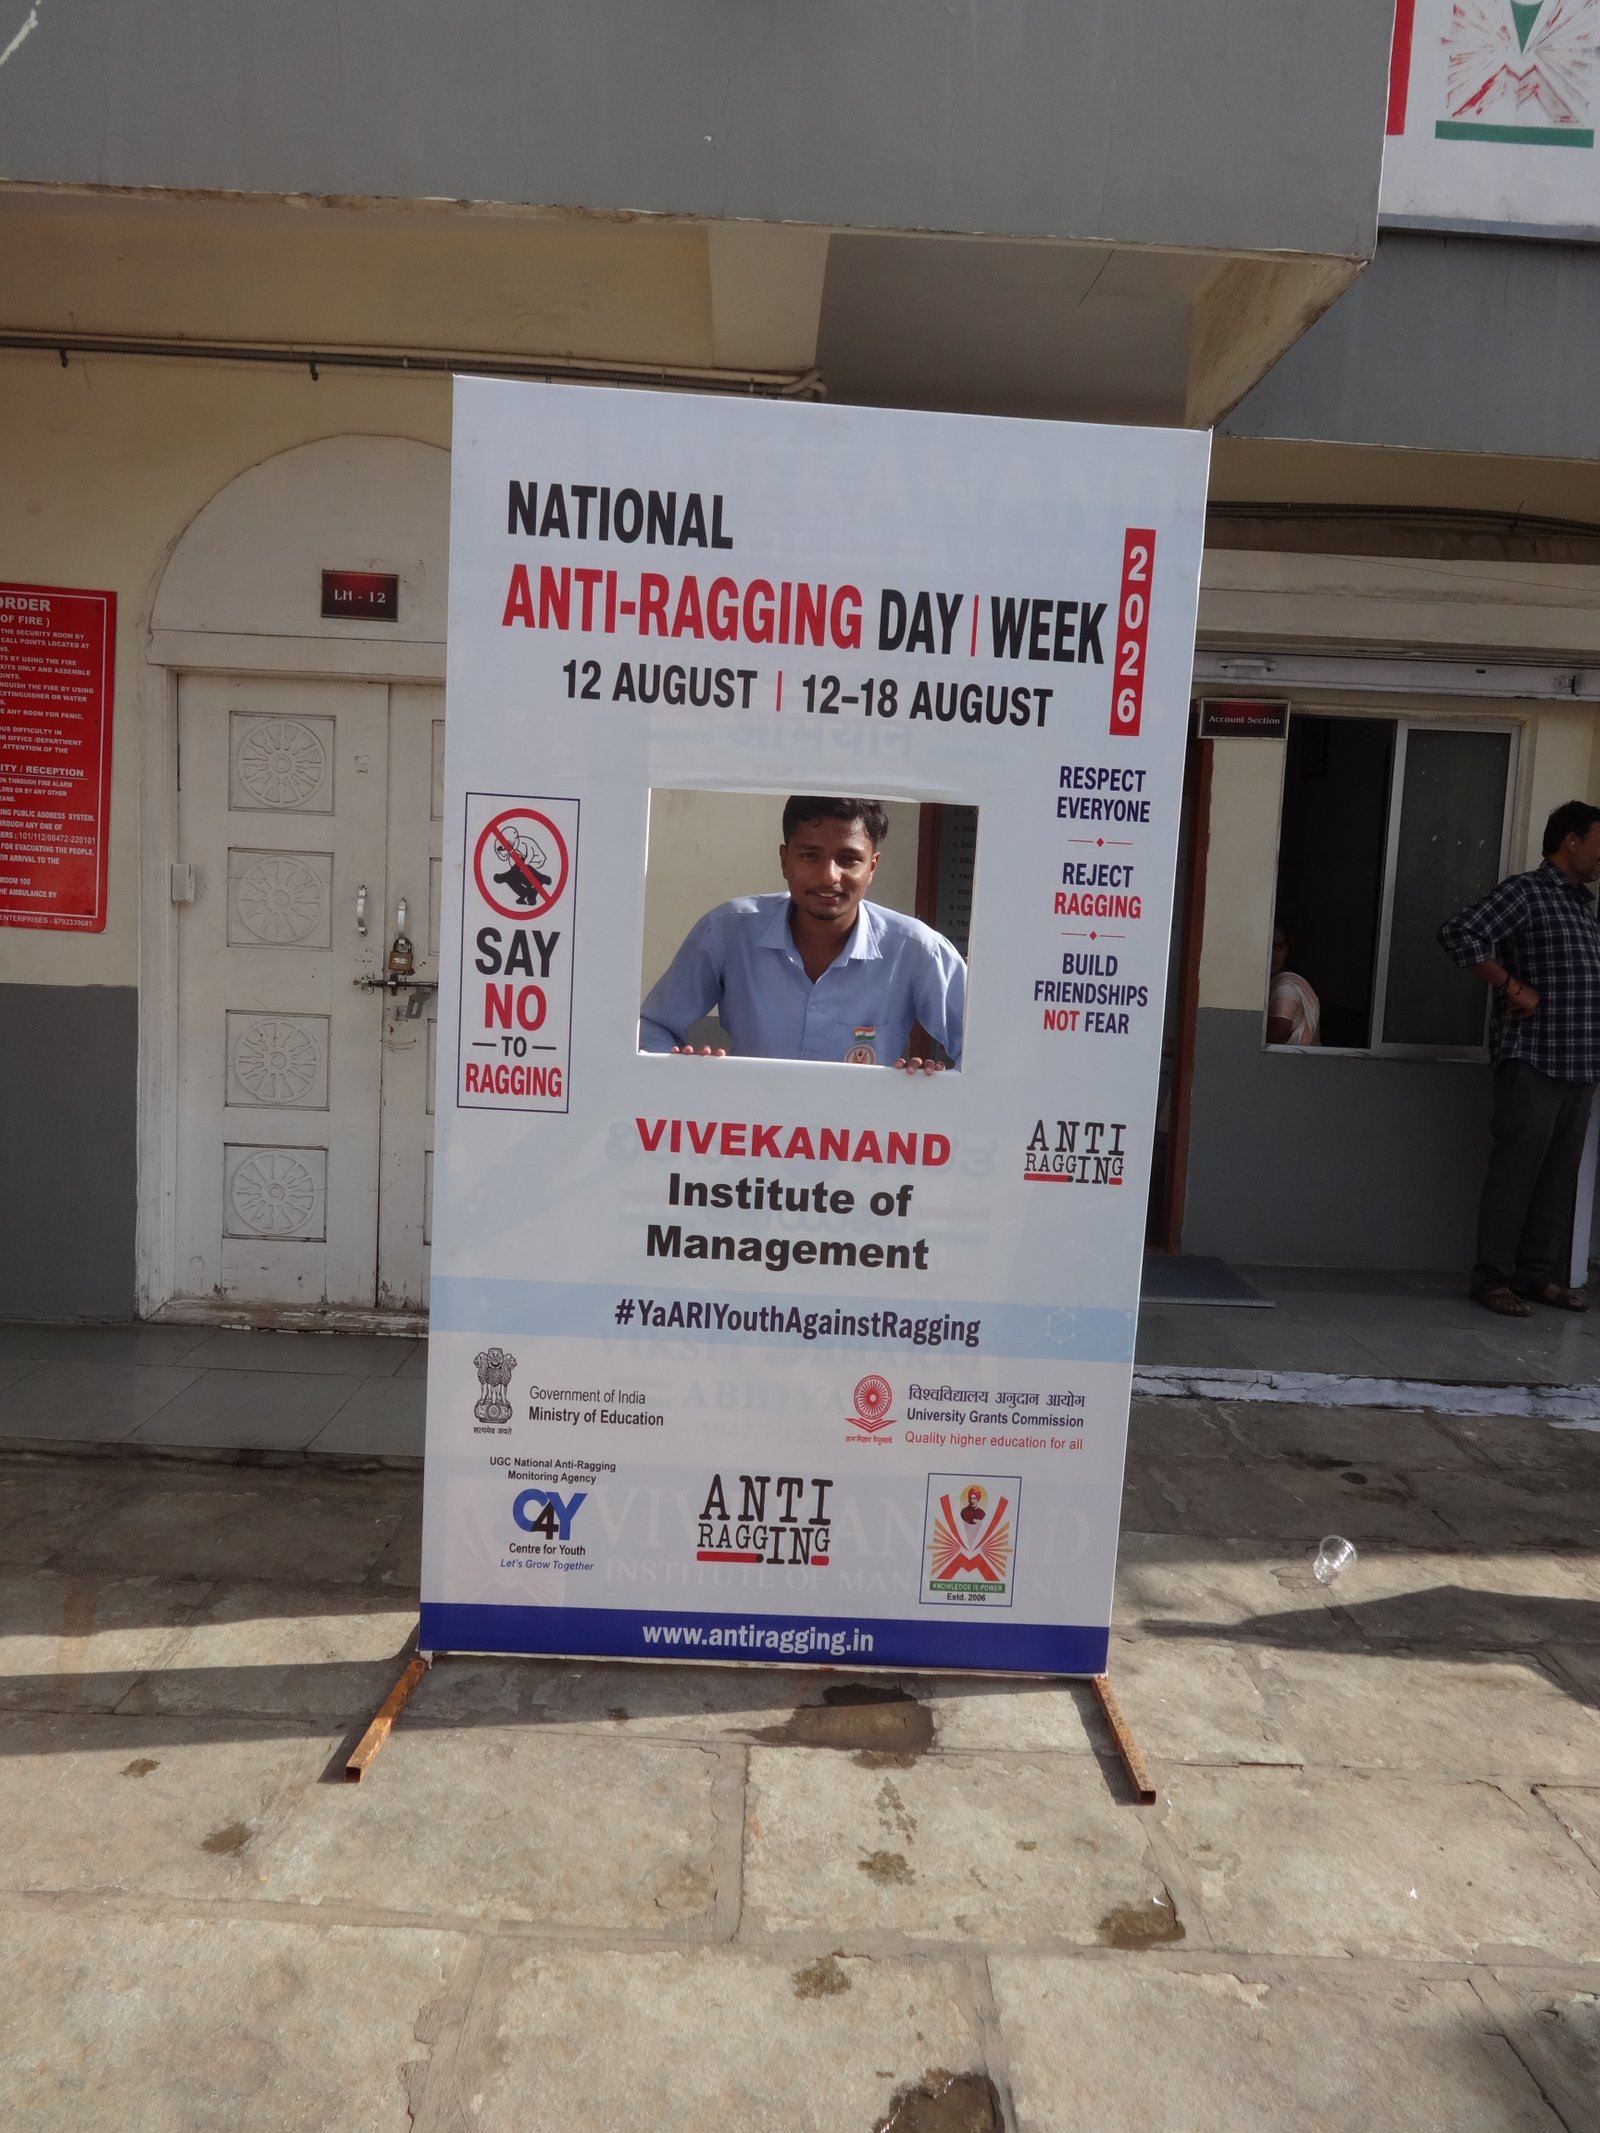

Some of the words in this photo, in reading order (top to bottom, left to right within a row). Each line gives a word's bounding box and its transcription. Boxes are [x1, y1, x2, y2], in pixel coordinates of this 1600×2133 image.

[508, 480, 733, 549] NATIONAL
[334, 589, 353, 601] LH
[369, 592, 386, 603] 12
[0, 614, 14, 623] OF
[18, 616, 43, 626] FIRE
[502, 563, 862, 650] ANTI-RAGGING
[878, 588, 964, 655] DAY
[991, 596, 1108, 664] WEEK
[16, 629, 50, 638] SECURITY
[1117, 546, 1148, 723] 2026
[48, 641, 80, 649] LOCATED
[54, 668, 91, 676] ASSEMBLE
[62, 694, 88, 702] WATER
[563, 659, 601, 700] 12
[612, 662, 758, 709] AUGUST
[909, 680, 1053, 727] AUGUST
[12, 726, 53, 735] DIFFICULTY
[1208, 714, 1245, 724] Account
[1248, 716, 1280, 726] Section
[2, 744, 42, 752] ATTENTION
[26, 766, 84, 777] RECEPTION
[1059, 766, 1146, 792] RESPECT
[13, 810, 36, 818] PUBLIC
[36, 810, 66, 820] ADDRESS
[1056, 796, 1150, 822] EVERYONE
[25, 821, 38, 830] ANY
[10, 854, 36, 863] ARRIVAL
[14, 844, 54, 853] EVACUATING
[1062, 862, 1134, 888] REJECT
[9, 889, 47, 898] AMBULANCE
[1054, 892, 1142, 919] RAGGING
[475, 927, 561, 978] SAY
[1062, 953, 1118, 976] BUILD
[1034, 980, 1148, 1007] FRIENDSHIPS
[484, 982, 547, 1031] NO
[1043, 1009, 1080, 1032] NOT
[1084, 1011, 1130, 1034] FEAR
[501, 1036, 527, 1058] TO
[465, 1062, 562, 1097] RAGGING
[635, 1118, 951, 1166] VIVEKANAND
[1026, 1120, 1126, 1156] ANTI
[1024, 1153, 1124, 1184] RAGGING
[668, 1172, 855, 1215] Institute
[870, 1185, 914, 1217] of
[646, 1224, 929, 1272] Management
[530, 1386, 600, 1403] Government
[604, 1389, 616, 1403] of
[618, 1391, 646, 1405] India
[908, 1384, 988, 1404] विश्वविद्यालय
[994, 1390, 1040, 1408] अनुदान
[1046, 1391, 1086, 1408] आयोग
[528, 1406, 580, 1426] Ministry
[584, 1409, 598, 1424] of
[600, 1410, 664, 1426] Education
[906, 1407, 966, 1425] University
[969, 1410, 1008, 1425] Grants
[1012, 1412, 1084, 1428] Commission
[905, 1430, 946, 1446] Quality
[950, 1433, 986, 1448] higher
[990, 1435, 1046, 1448] education
[1050, 1436, 1066, 1450] for
[1070, 1438, 1084, 1450] all
[490, 1456, 512, 1466] UGC
[514, 1458, 553, 1469] National
[554, 1459, 616, 1472] Anti-Ragging
[508, 1470, 558, 1482] Monitoring
[561, 1472, 597, 1484] Agency
[699, 1474, 834, 1525] ANTI
[512, 1488, 588, 1540] C4Y
[509, 1543, 540, 1554] Centre
[543, 1544, 556, 1554] for
[559, 1544, 586, 1556] Youth
[697, 1523, 830, 1565] RAGGING
[500, 1558, 522, 1568] Let's
[525, 1560, 550, 1570] Grow
[553, 1561, 594, 1572] Together
[946, 1592, 966, 1600] Estd.
[968, 1594, 986, 1602] 2006
[642, 1622, 874, 1655] www.antiragging.in
